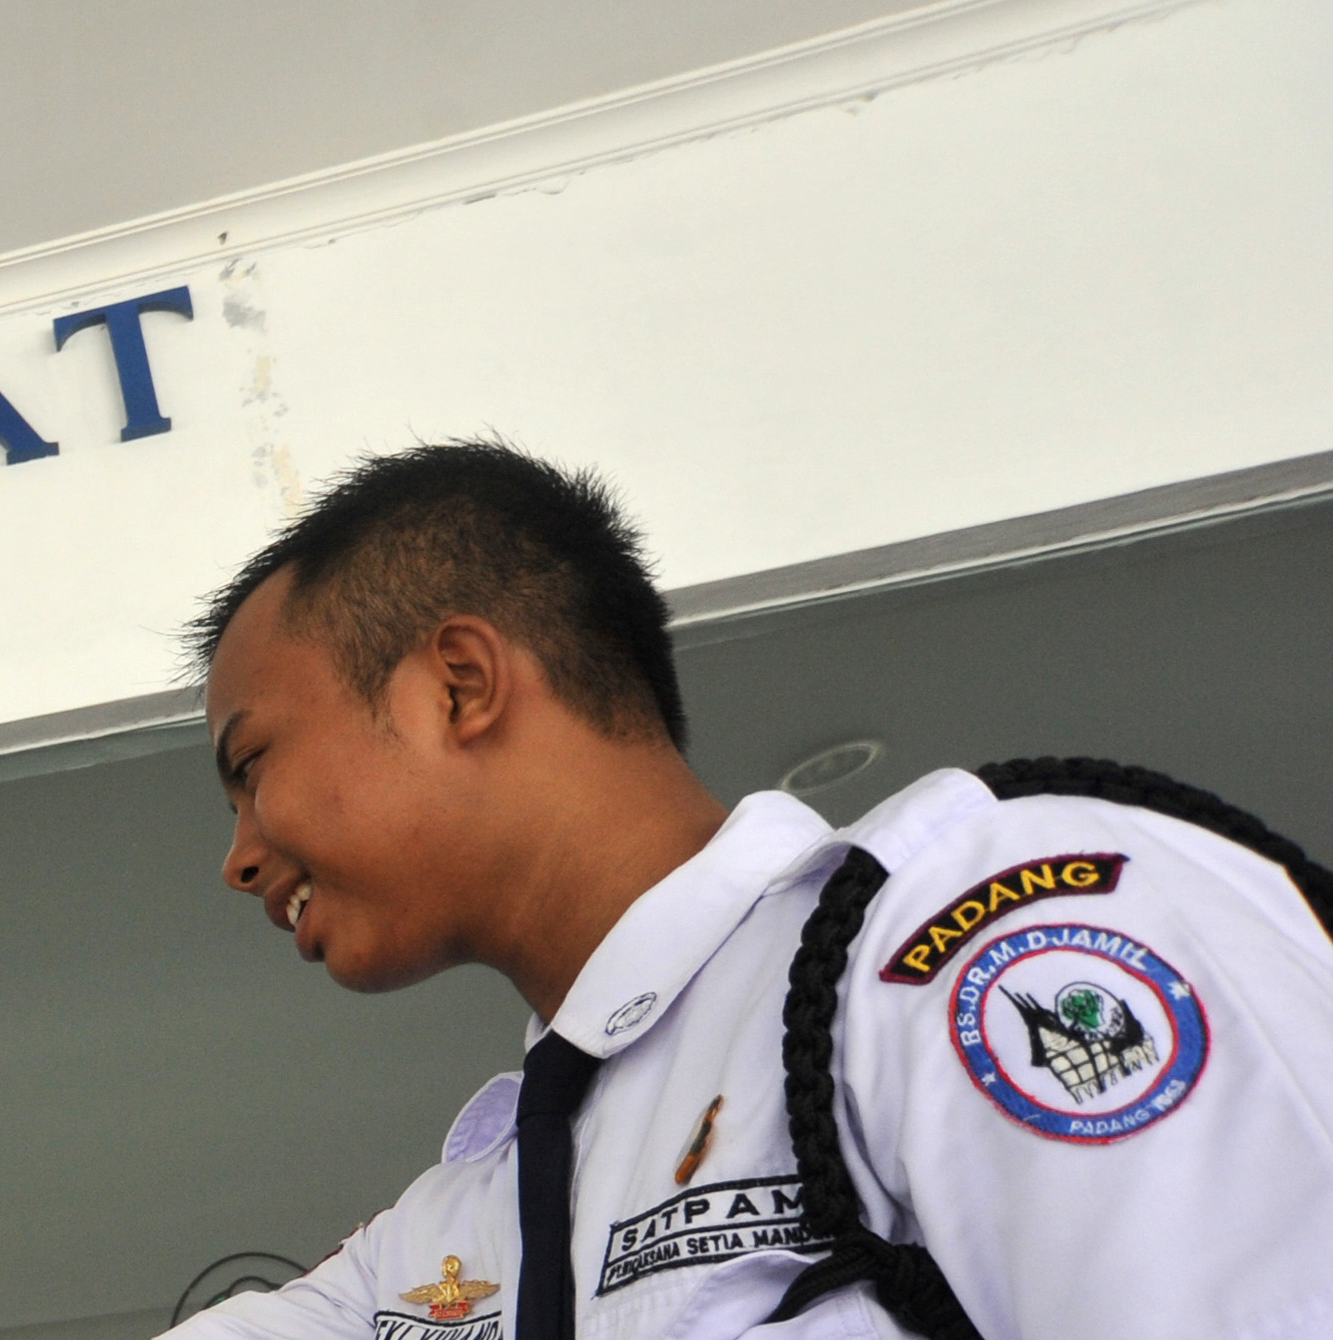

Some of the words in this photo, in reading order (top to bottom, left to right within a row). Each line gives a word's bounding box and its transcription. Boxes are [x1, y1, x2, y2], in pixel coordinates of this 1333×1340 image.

[902, 861, 1100, 973] PADANG
[1070, 1109, 1150, 1135] PADANG
[621, 1186, 804, 1252] SATPAM
[686, 1232, 745, 1256] SETIA
